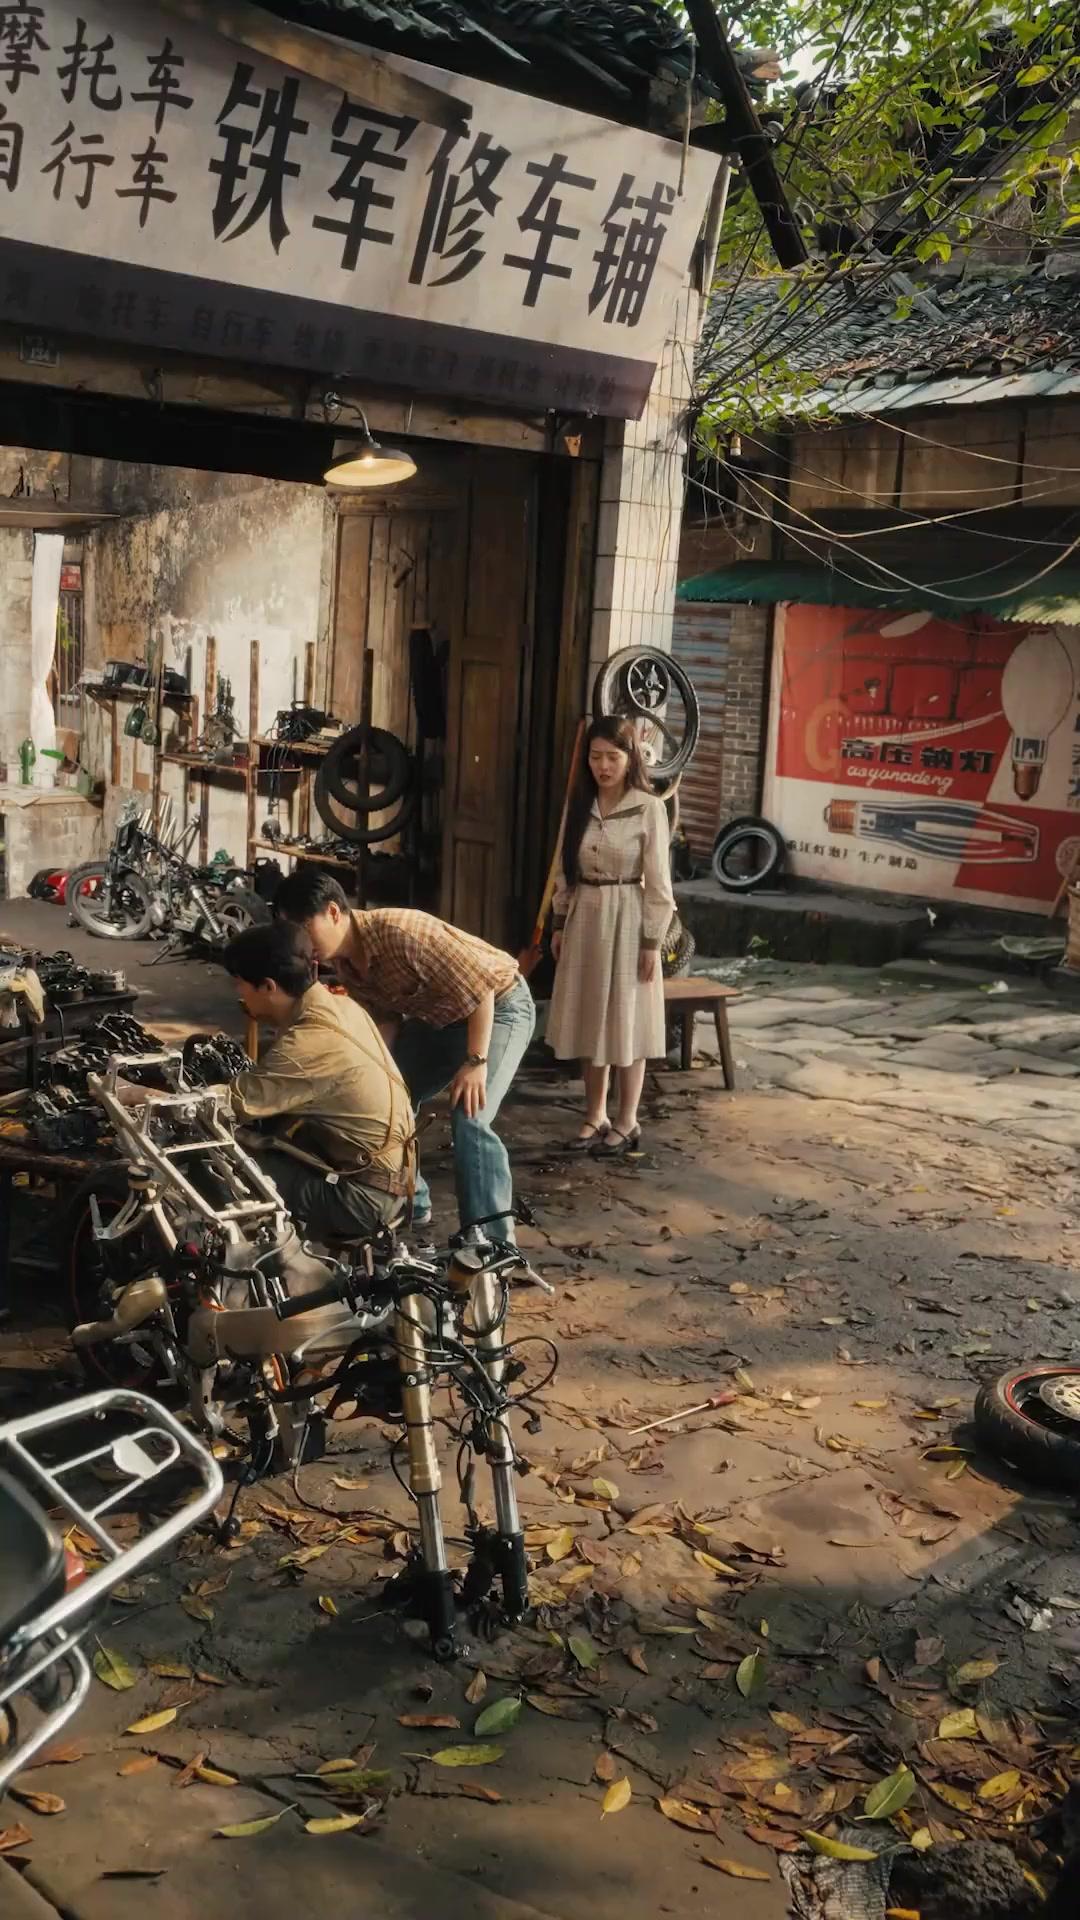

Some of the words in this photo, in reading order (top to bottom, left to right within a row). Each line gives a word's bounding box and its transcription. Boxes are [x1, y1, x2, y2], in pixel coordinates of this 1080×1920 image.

[0, 0, 195, 134] 摩托车
[208, 61, 676, 328] 铁军修车铺
[841, 738, 996, 773] 高压钠灯
[858, 850, 918, 871] 生产制造
